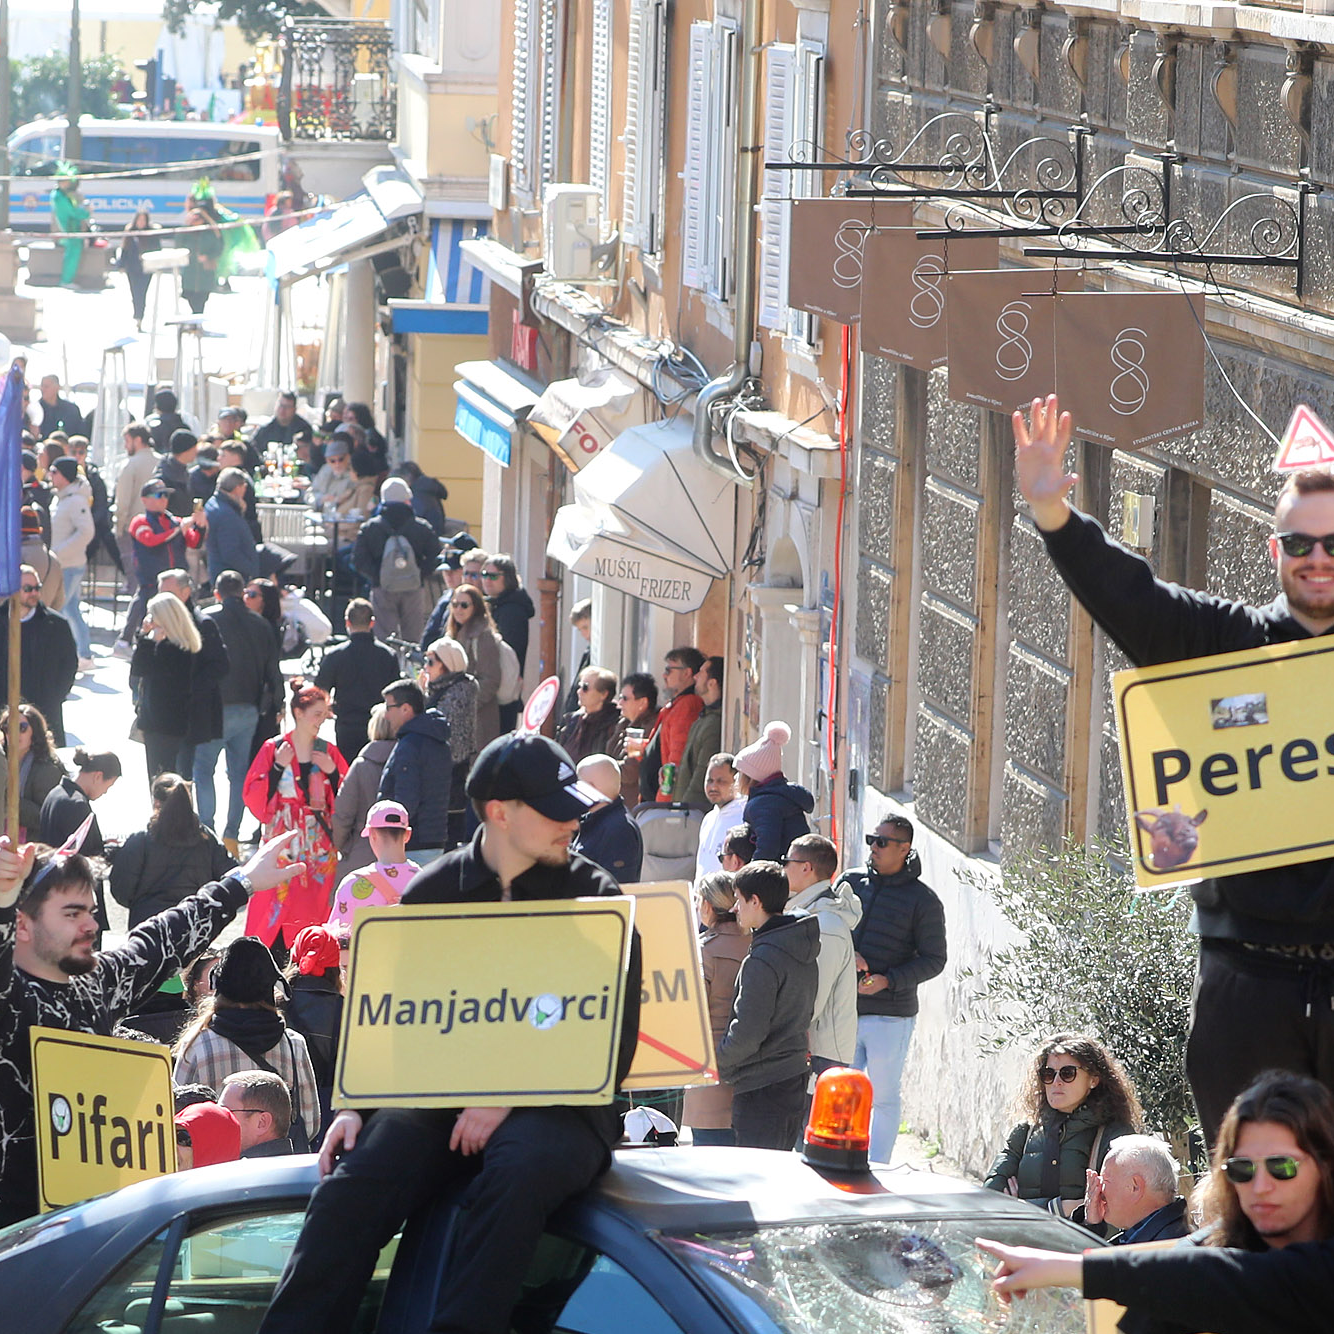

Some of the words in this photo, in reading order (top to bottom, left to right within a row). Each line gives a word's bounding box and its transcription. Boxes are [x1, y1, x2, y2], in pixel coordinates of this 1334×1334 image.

[86, 197, 155, 211] OLICIJA
[568, 419, 604, 455] FO
[593, 556, 642, 580] MUŠKI
[638, 577, 693, 602] FRIZER
[356, 984, 612, 1036] Manjadvrci
[47, 1090, 168, 1174] Pifari
